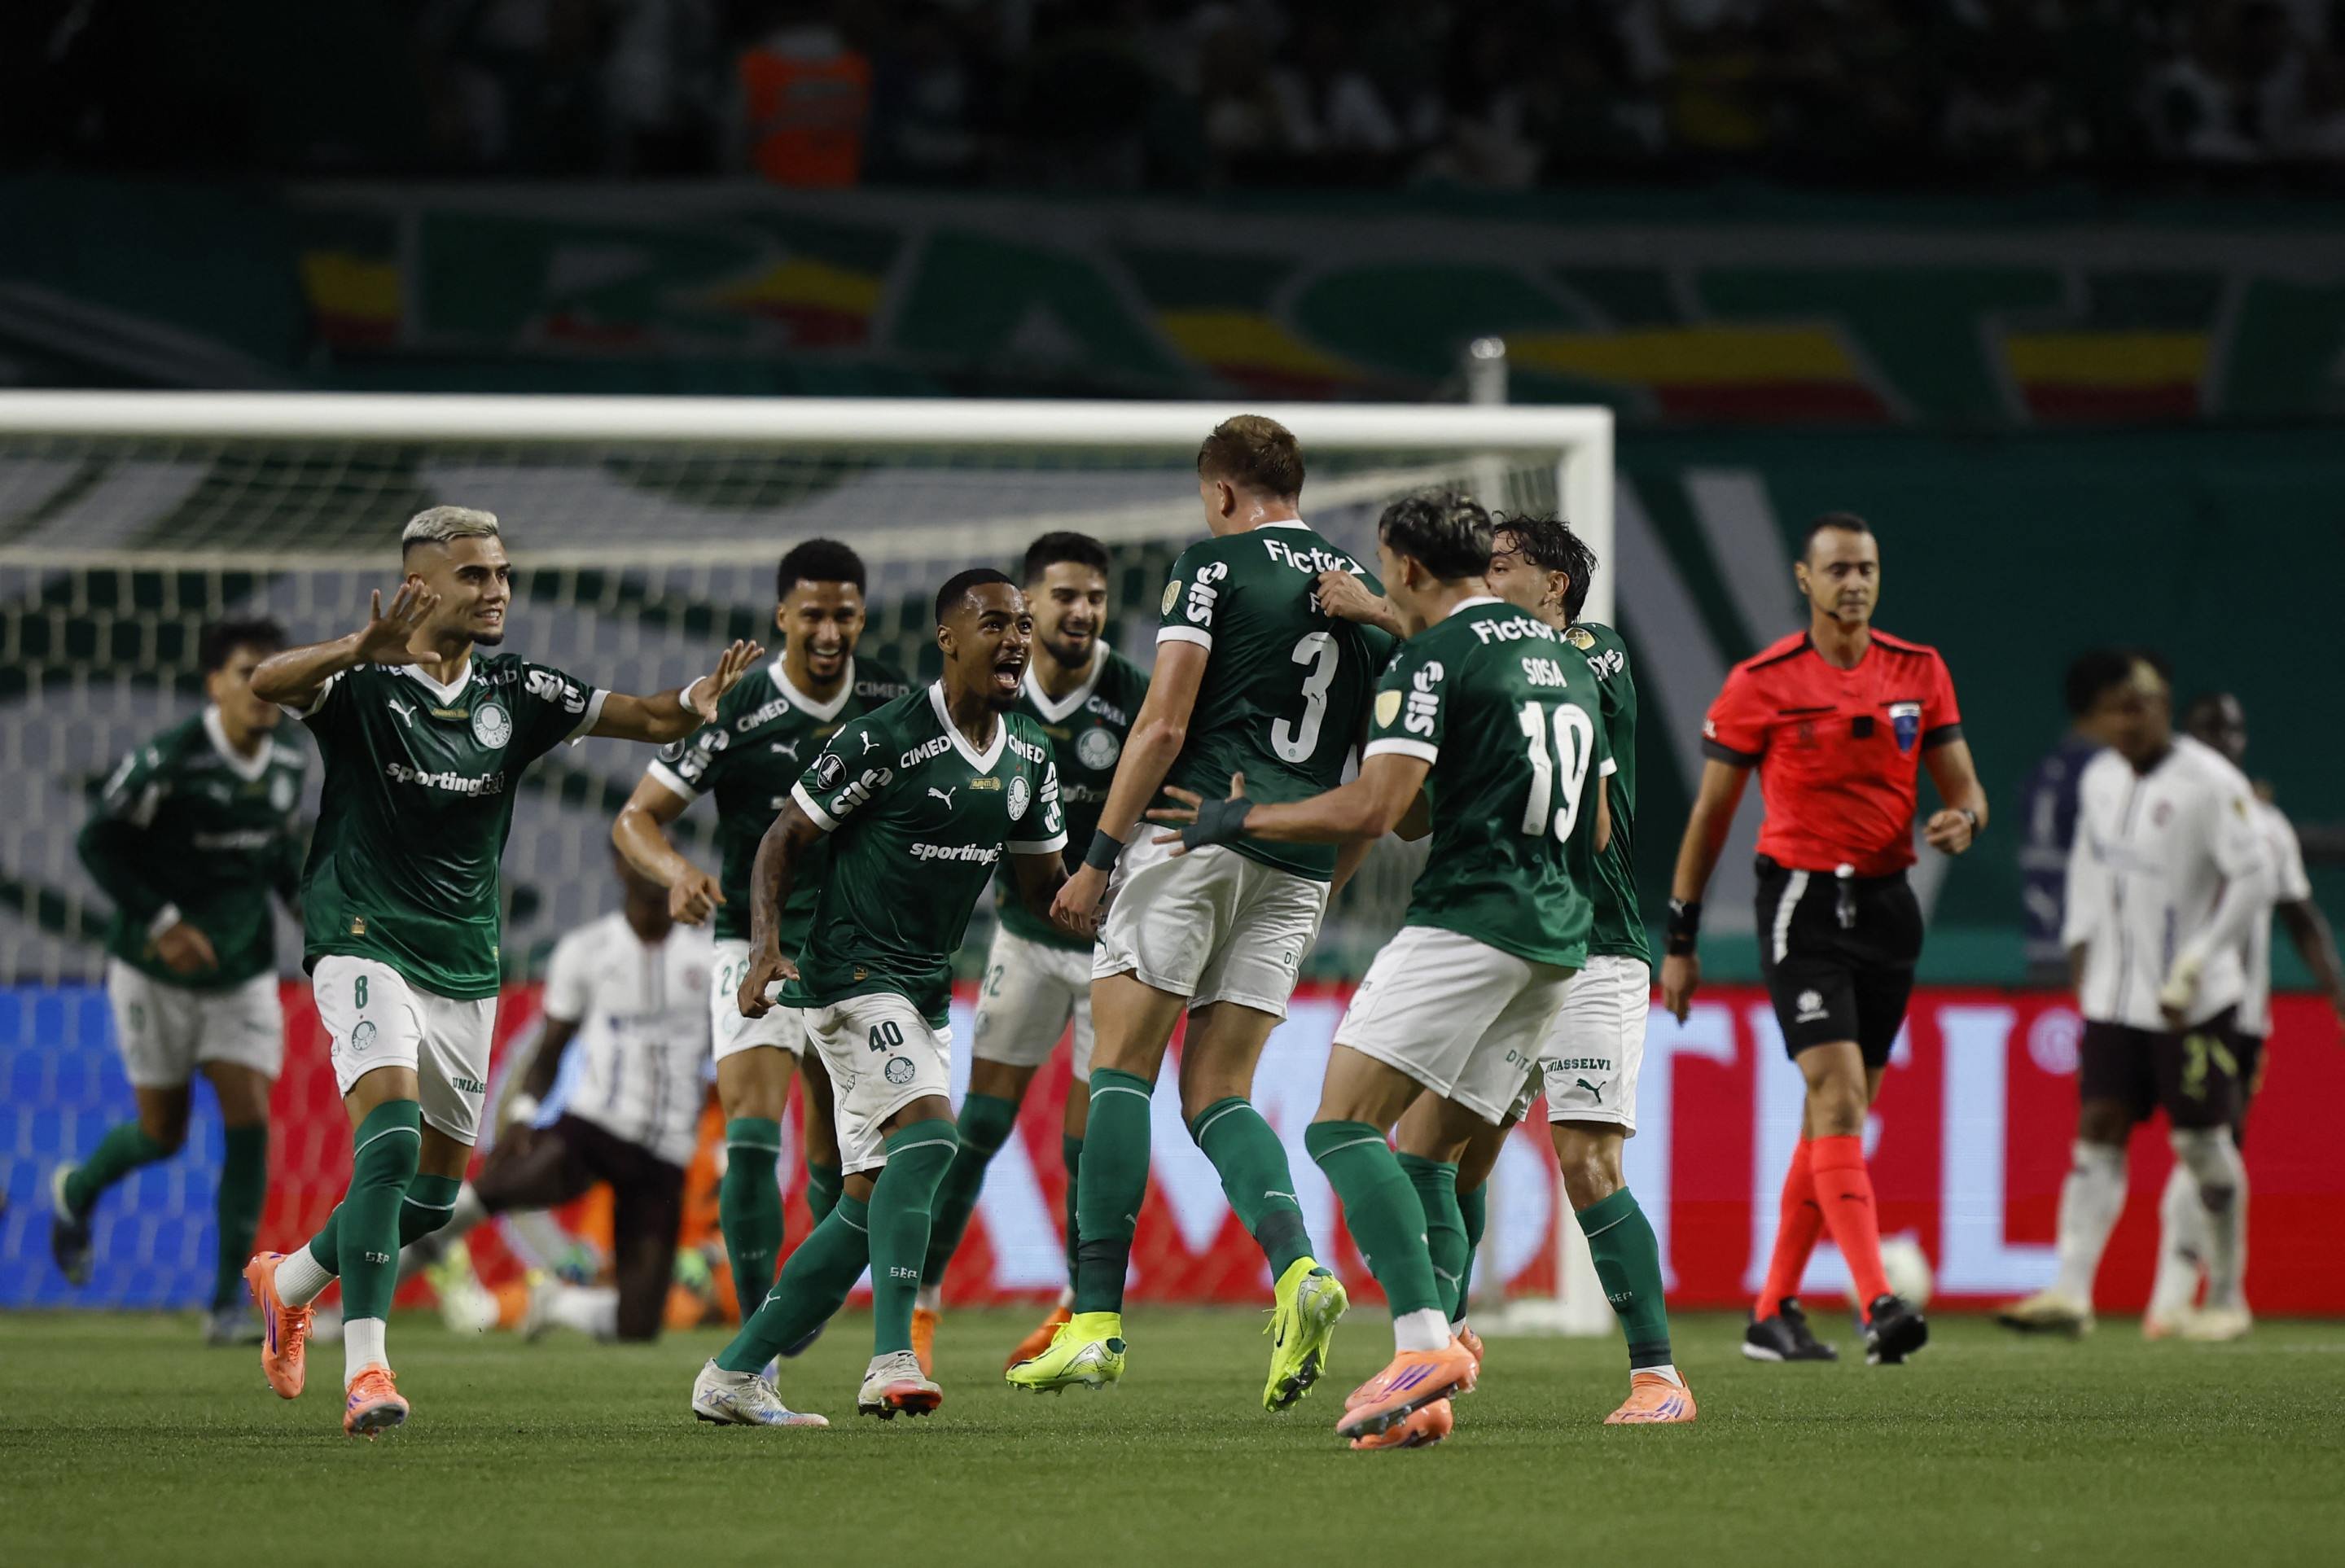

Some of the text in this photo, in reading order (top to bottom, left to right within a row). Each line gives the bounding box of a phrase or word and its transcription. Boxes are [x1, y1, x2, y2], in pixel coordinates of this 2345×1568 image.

[1263, 538, 1348, 575] Fictor
[1470, 615, 1556, 645] Fictor
[855, 680, 910, 698] CIMED
[1520, 656, 1568, 688] SOSA
[736, 697, 790, 733] CIMED
[1270, 631, 1339, 764] 3
[900, 734, 953, 769] CIMED
[1517, 700, 1594, 844] 19
[354, 975, 368, 1010] 8
[869, 1020, 905, 1053] 40
[888, 1266, 918, 1279] SEP
